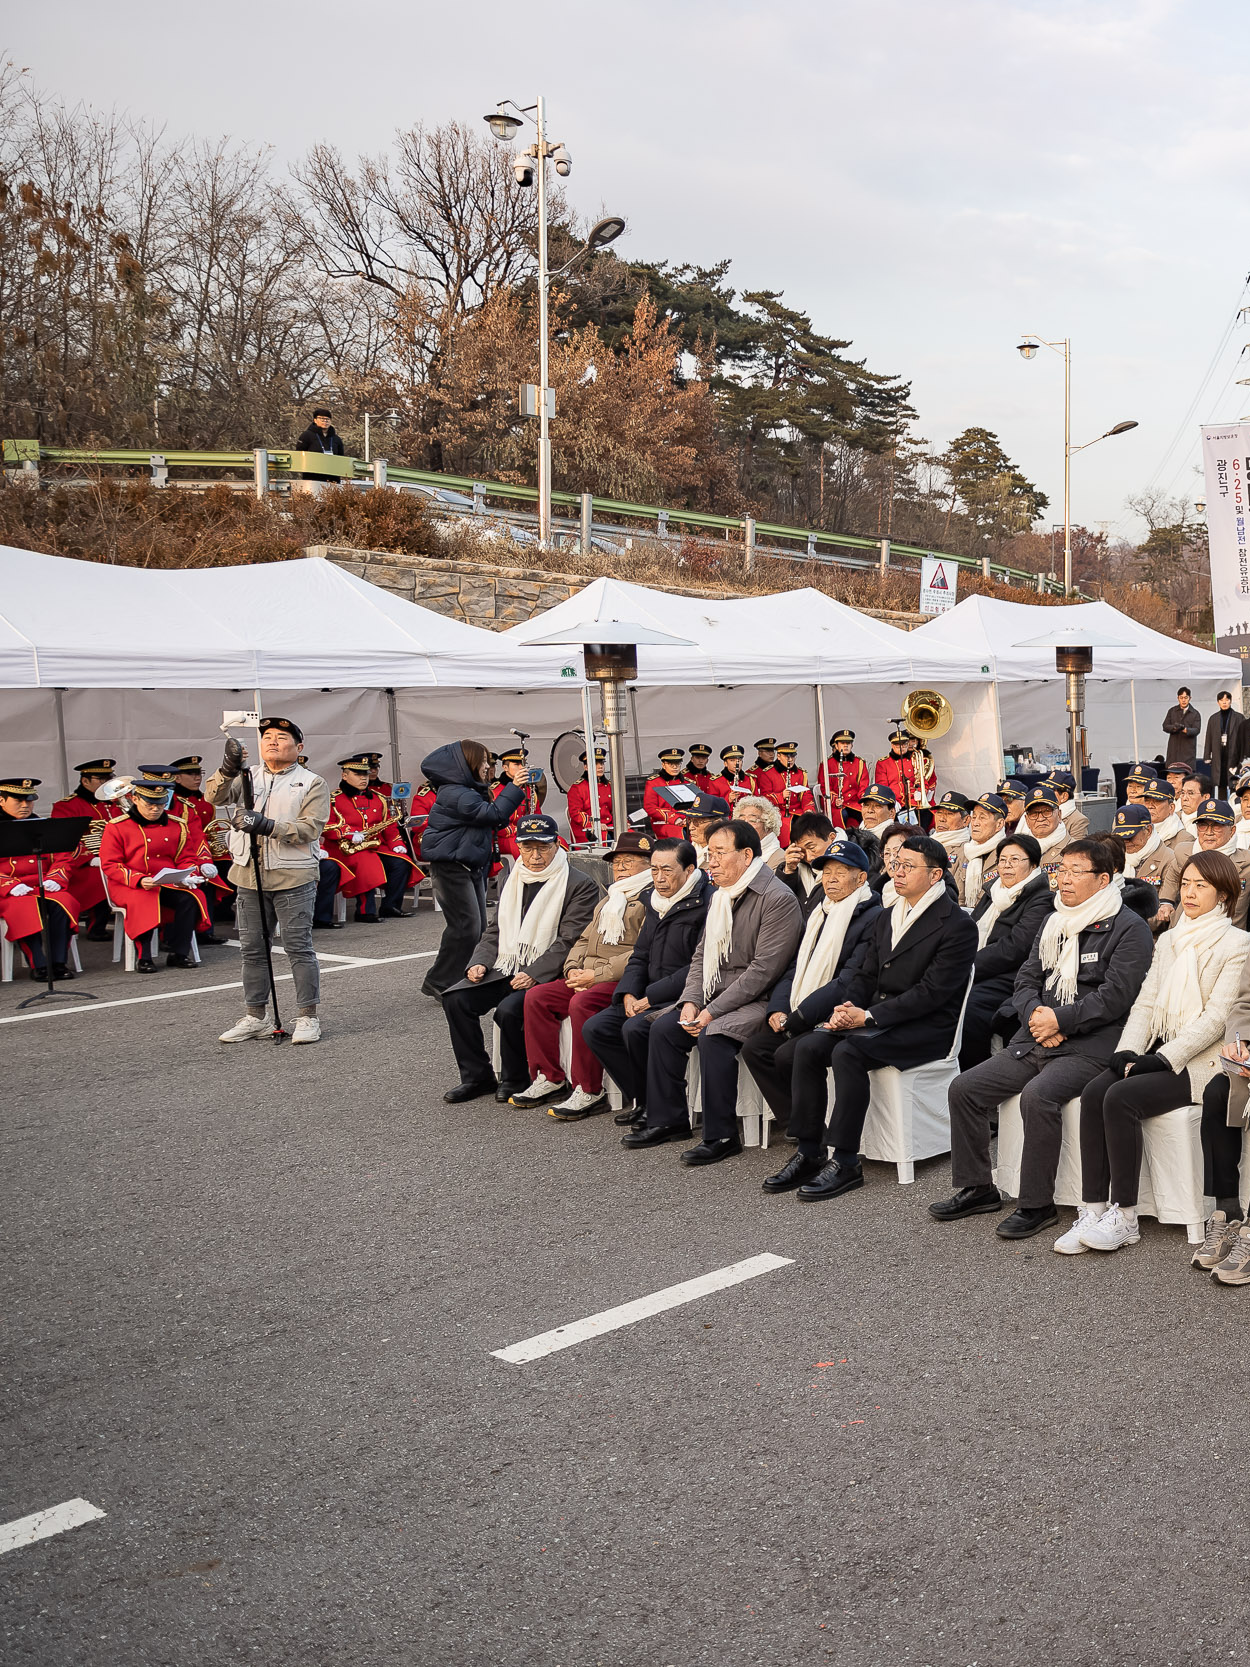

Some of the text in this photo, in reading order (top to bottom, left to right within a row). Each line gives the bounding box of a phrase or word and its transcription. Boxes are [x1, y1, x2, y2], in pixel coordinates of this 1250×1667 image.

[1216, 459, 1229, 498] 광진구
[1235, 505, 1244, 515] 및
[1236, 517, 1246, 545] 월남전
[1238, 548, 1250, 594] 참전유공자
